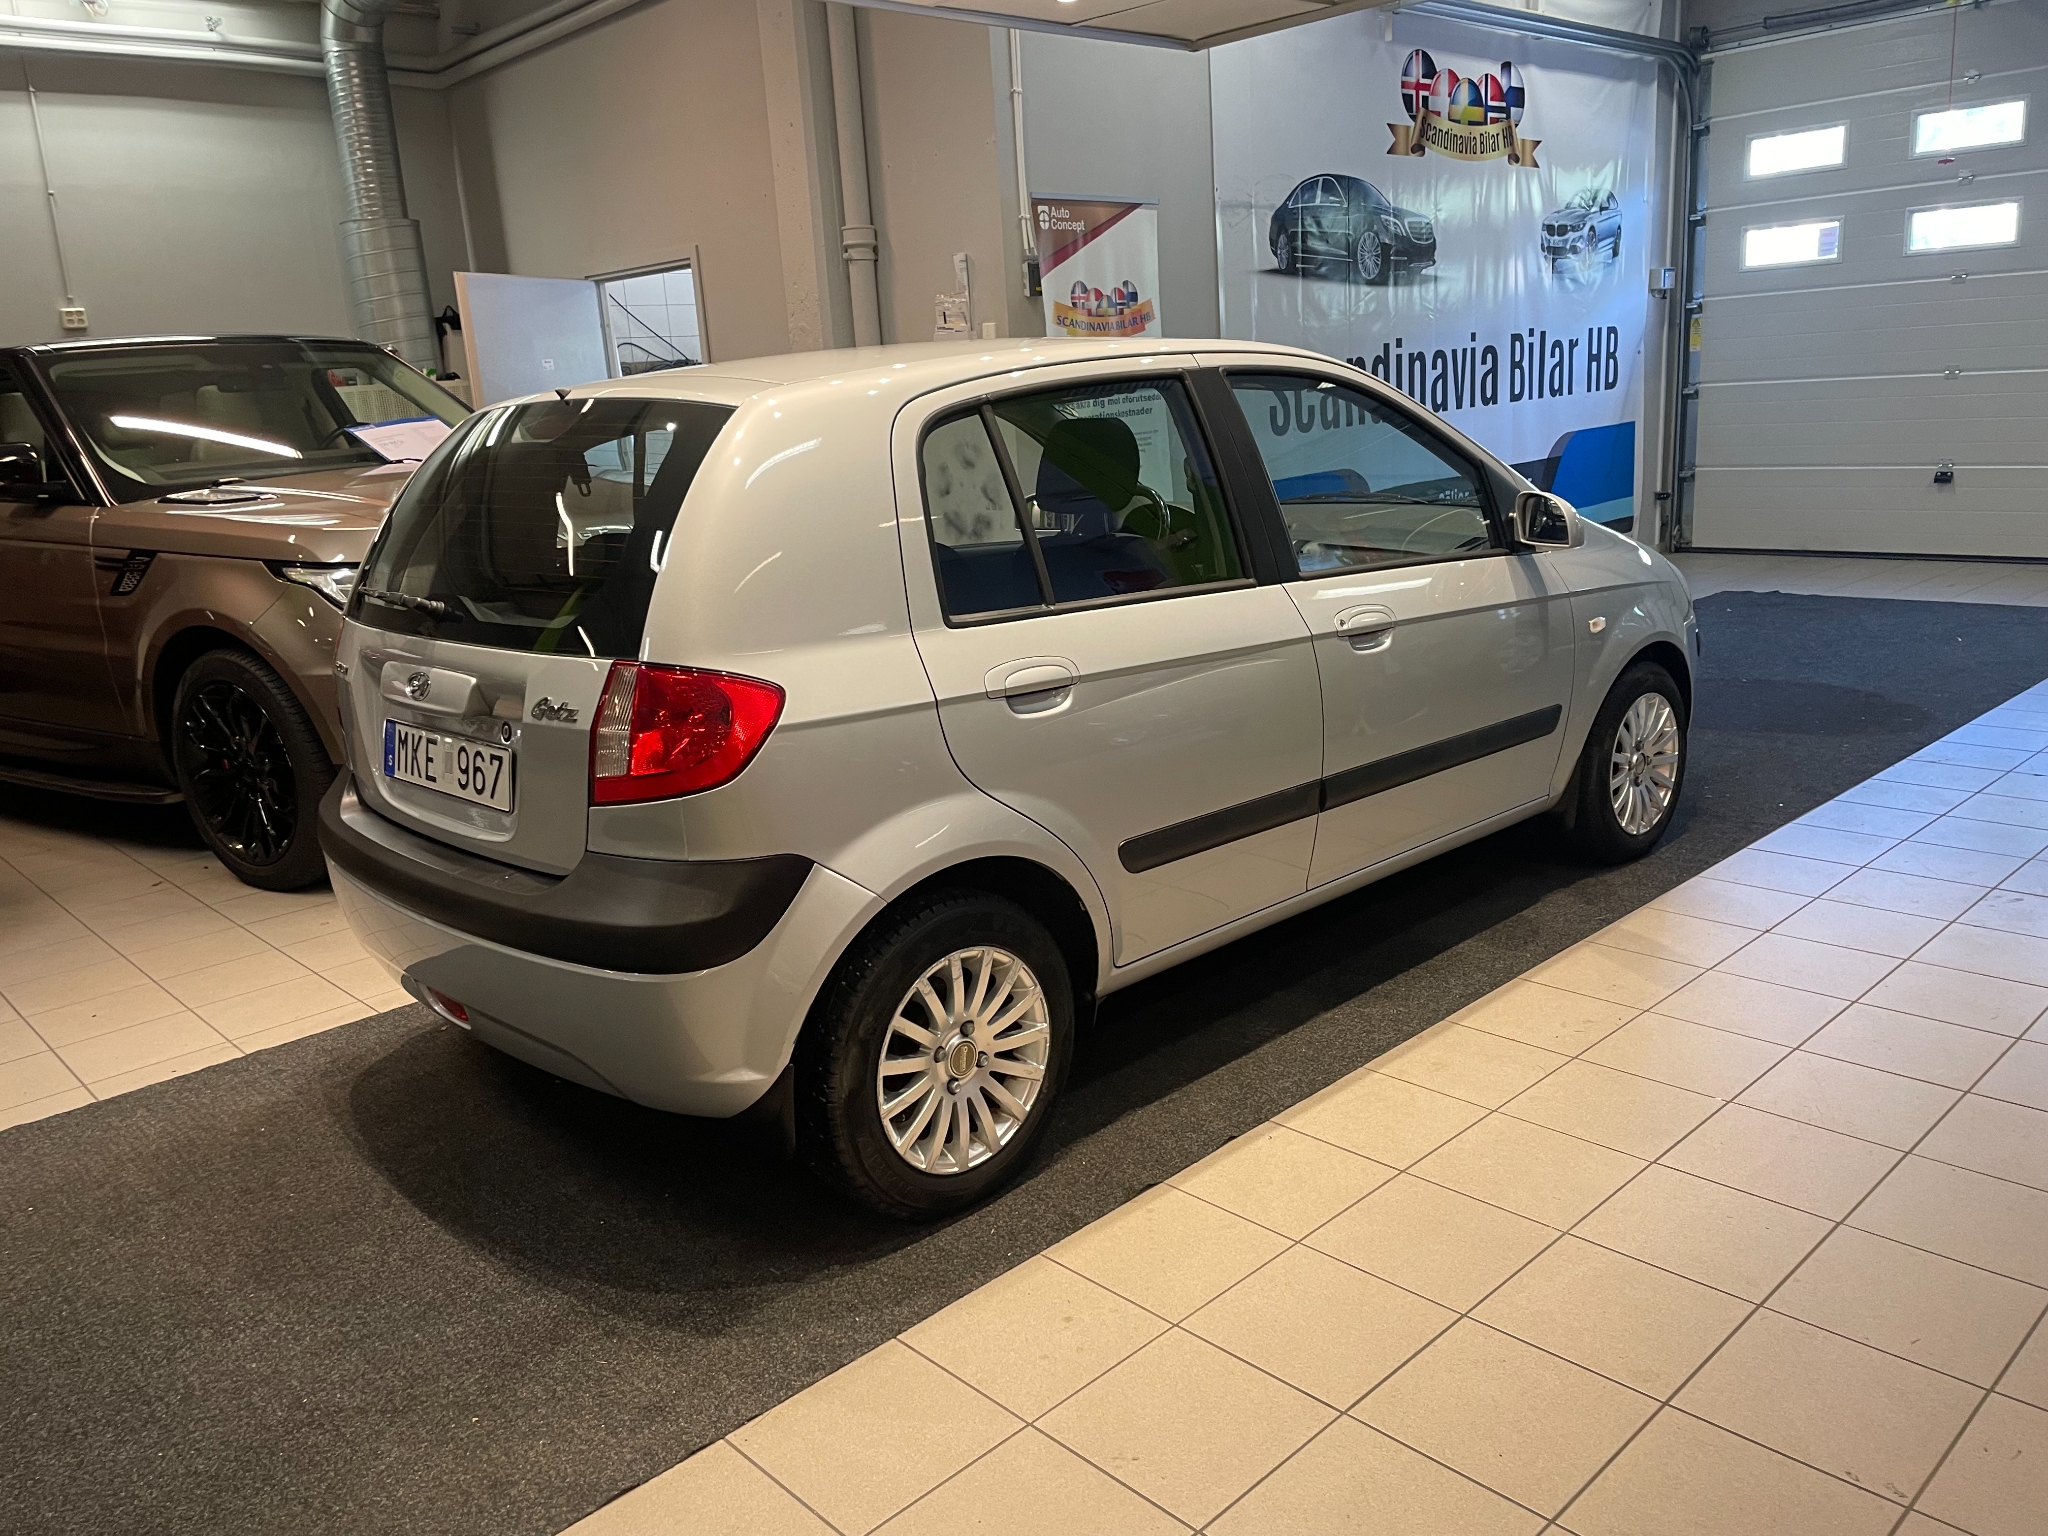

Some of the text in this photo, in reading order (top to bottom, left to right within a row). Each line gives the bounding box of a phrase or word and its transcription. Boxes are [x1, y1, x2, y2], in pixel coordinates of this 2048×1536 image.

[1420, 116, 1478, 155] Scandinavia
[1479, 131, 1500, 154] Bilar
[1050, 206, 1070, 218] Auto
[1050, 219, 1085, 233] Concept
[1056, 311, 1151, 331] SCANDINAVIA BILAR HB
[1508, 327, 1579, 403] Bilar
[1586, 326, 1619, 393] HB
[531, 697, 579, 723] Getz
[388, 754, 393, 766] S
[397, 729, 504, 799] MKE 967
